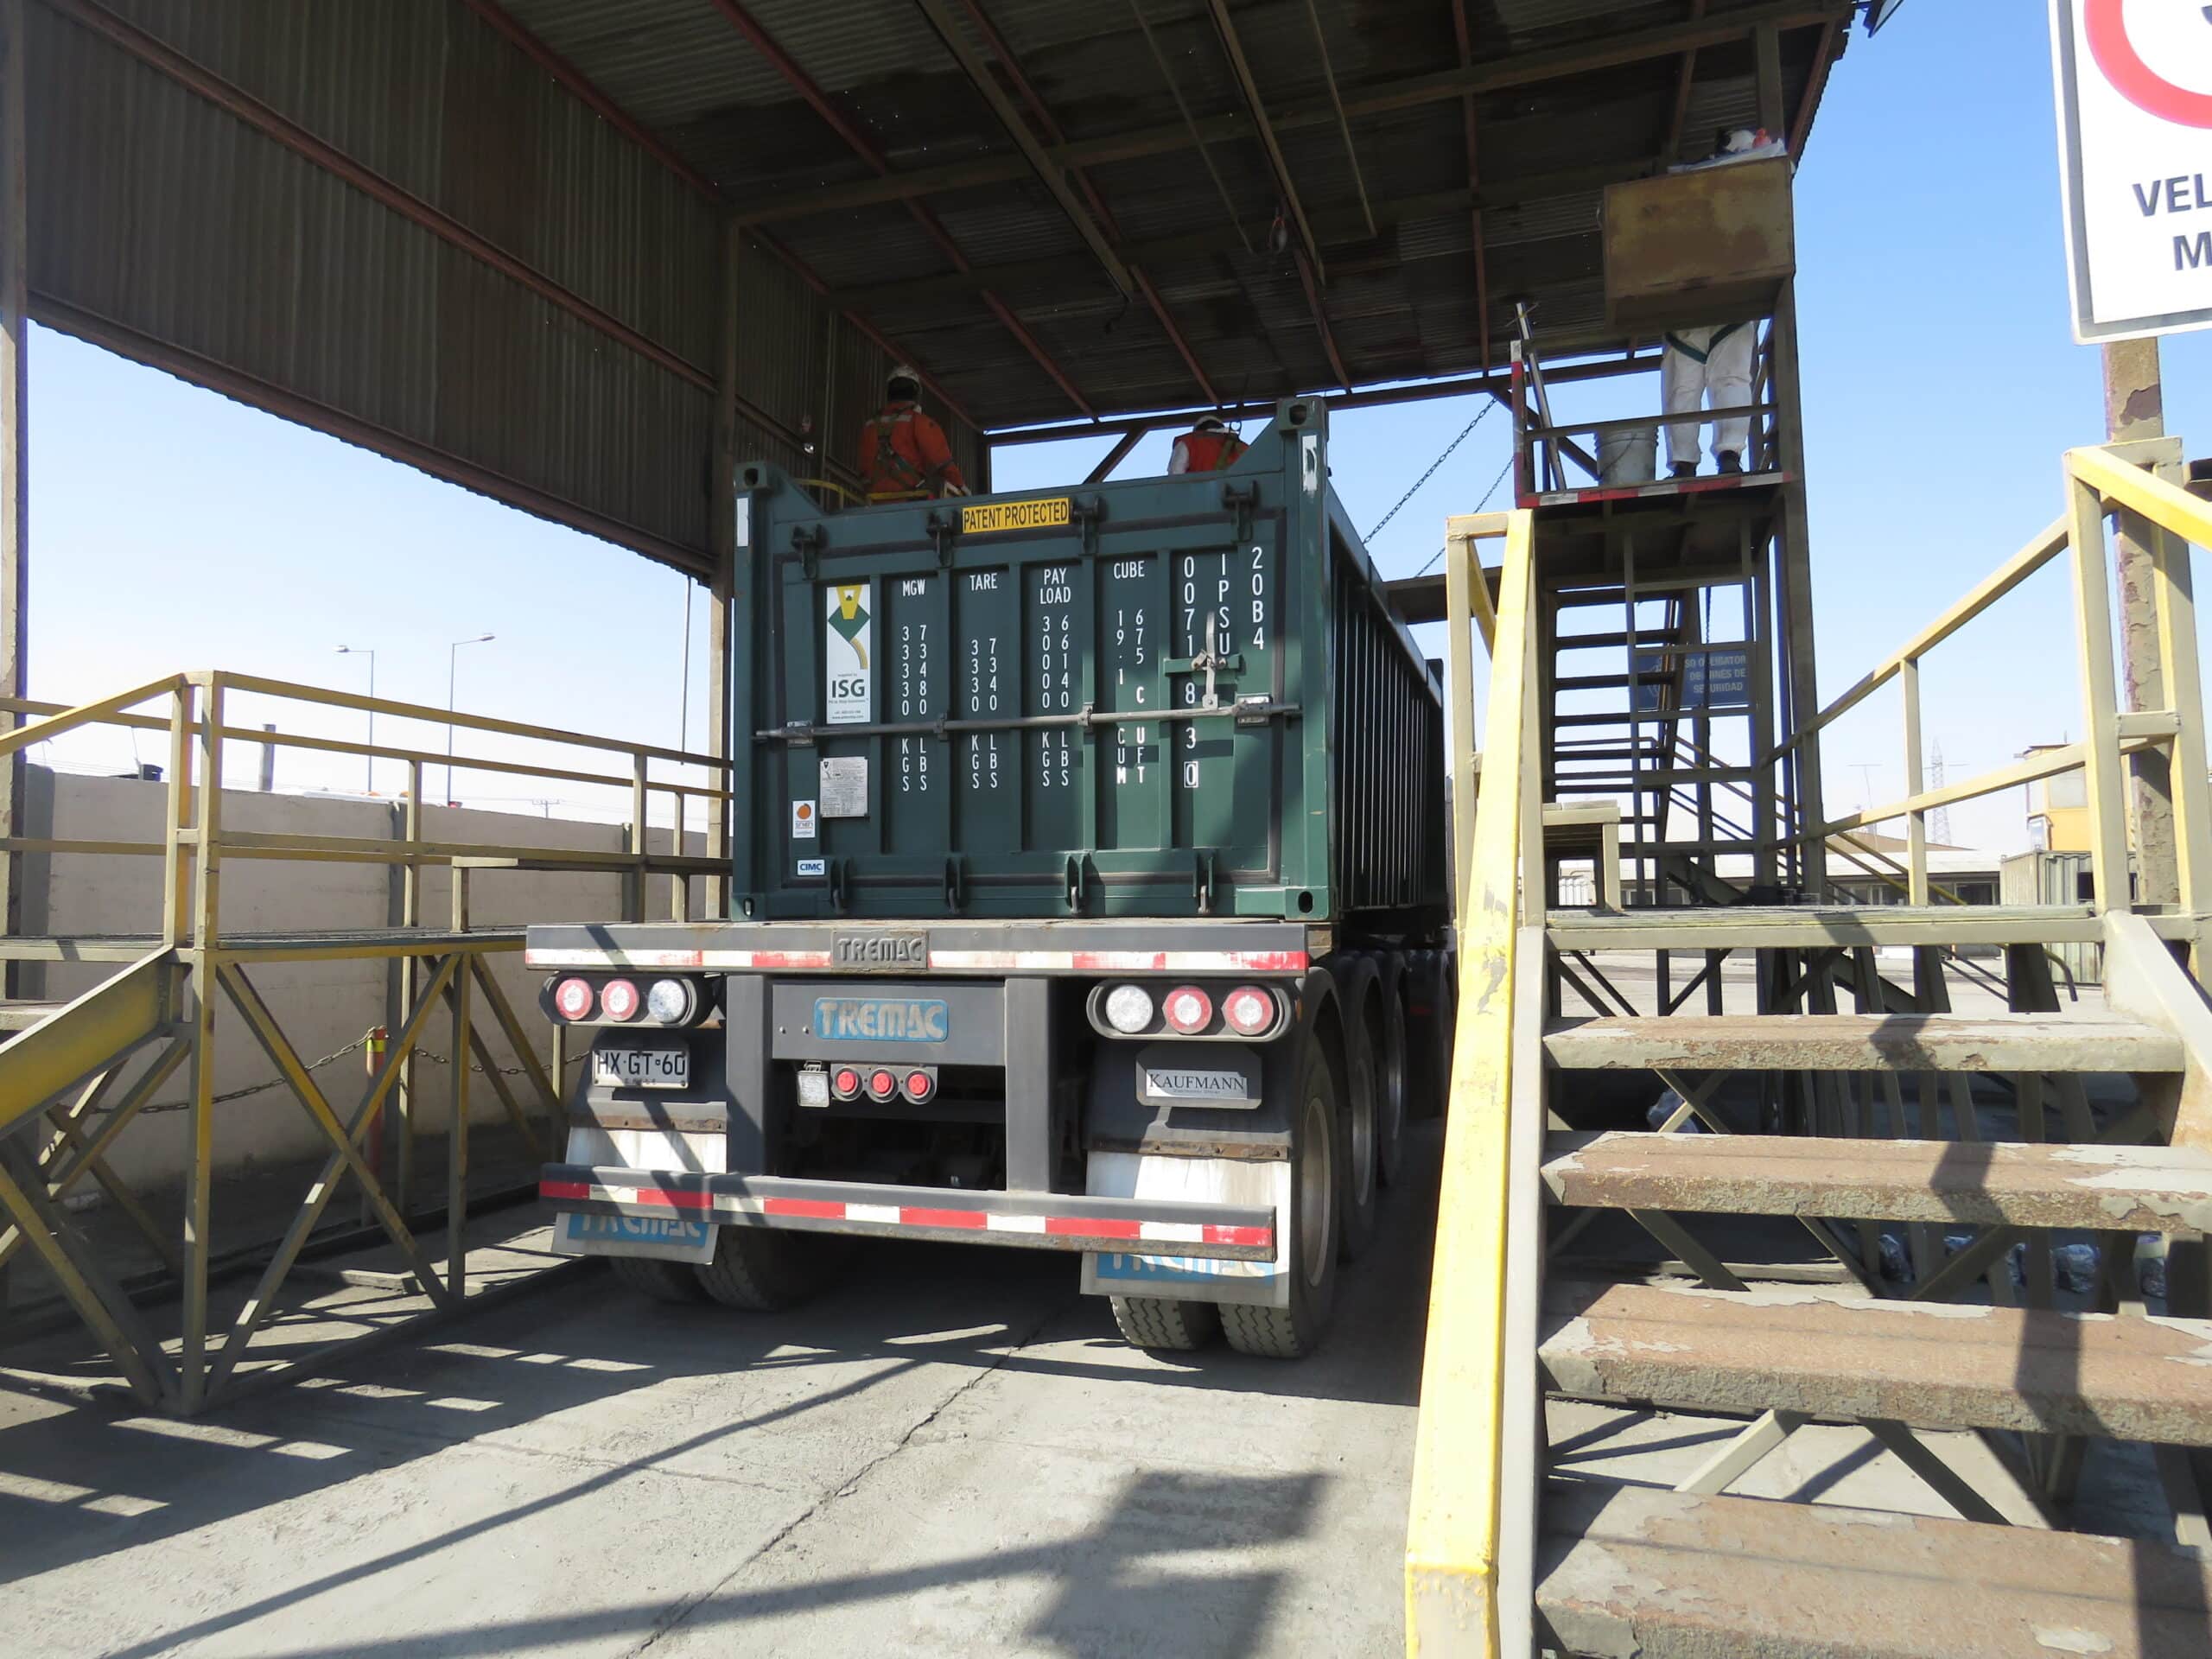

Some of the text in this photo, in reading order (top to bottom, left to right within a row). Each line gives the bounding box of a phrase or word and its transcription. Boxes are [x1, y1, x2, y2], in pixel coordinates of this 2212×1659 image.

[963, 501, 1067, 530] PATENT PROTECTED
[1044, 568, 1067, 585] PAY
[1113, 560, 1145, 579] CUBE
[902, 579, 926, 596] MGW
[969, 573, 998, 591] TARE
[1039, 587, 1071, 604] LOAD
[1218, 554, 1230, 655] IPSU
[1252, 547, 1264, 650] 20B4
[832, 679, 865, 698] ISG
[1693, 682, 1743, 693] SEURIDAD
[837, 937, 921, 963] TREMAC
[818, 1002, 945, 1039] TREMAC
[1149, 1073, 1244, 1090] KAUFMANN
